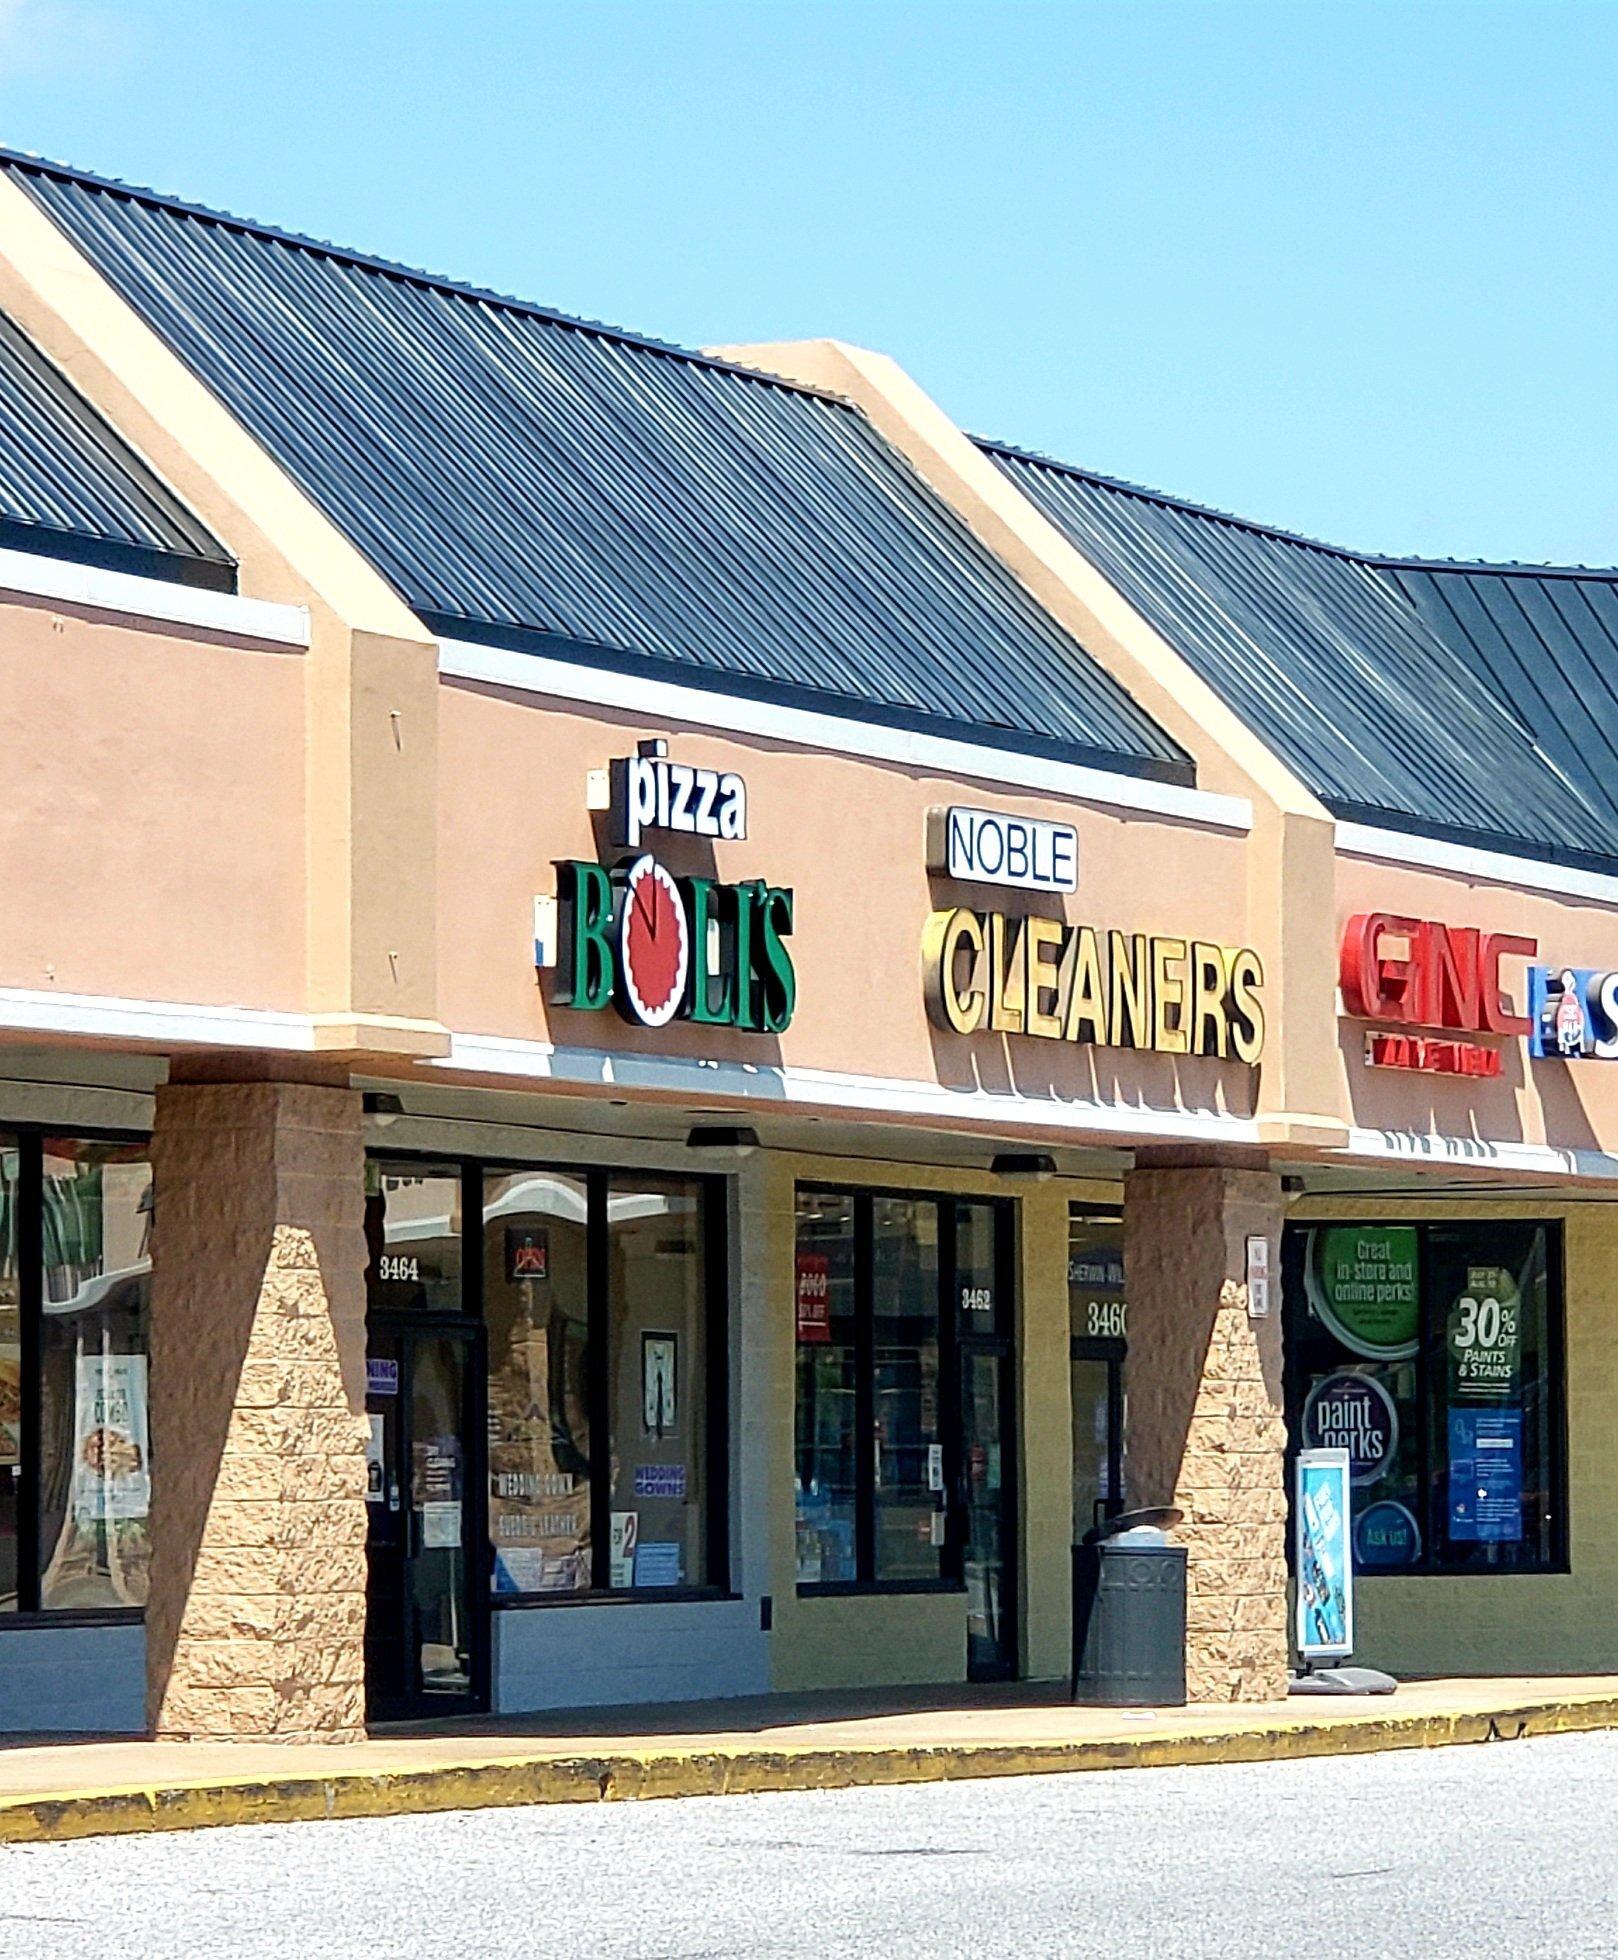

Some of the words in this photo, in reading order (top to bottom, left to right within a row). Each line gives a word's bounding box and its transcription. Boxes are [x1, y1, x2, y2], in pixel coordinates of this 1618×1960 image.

[629, 739, 748, 848] pizza
[951, 813, 1074, 886] NOBLE
[1358, 911, 1538, 1037] GNC
[938, 907, 1266, 1065] CLEANERS
[1357, 1241, 1391, 1260] Great
[380, 1256, 419, 1280] 3464
[1388, 1261, 1413, 1280] and
[962, 1288, 990, 1310] 3462
[1335, 1284, 1375, 1301] online
[1497, 1333, 1519, 1347] OFF
[1463, 1348, 1506, 1363] PAINTS
[1457, 1364, 1468, 1378] &
[1470, 1362, 1513, 1379] STAINS
[1317, 1394, 1372, 1435] paint
[635, 1465, 686, 1481] WEDDING
[635, 1481, 686, 1497] GOWNS
[1366, 1529, 1387, 1545] Ask
